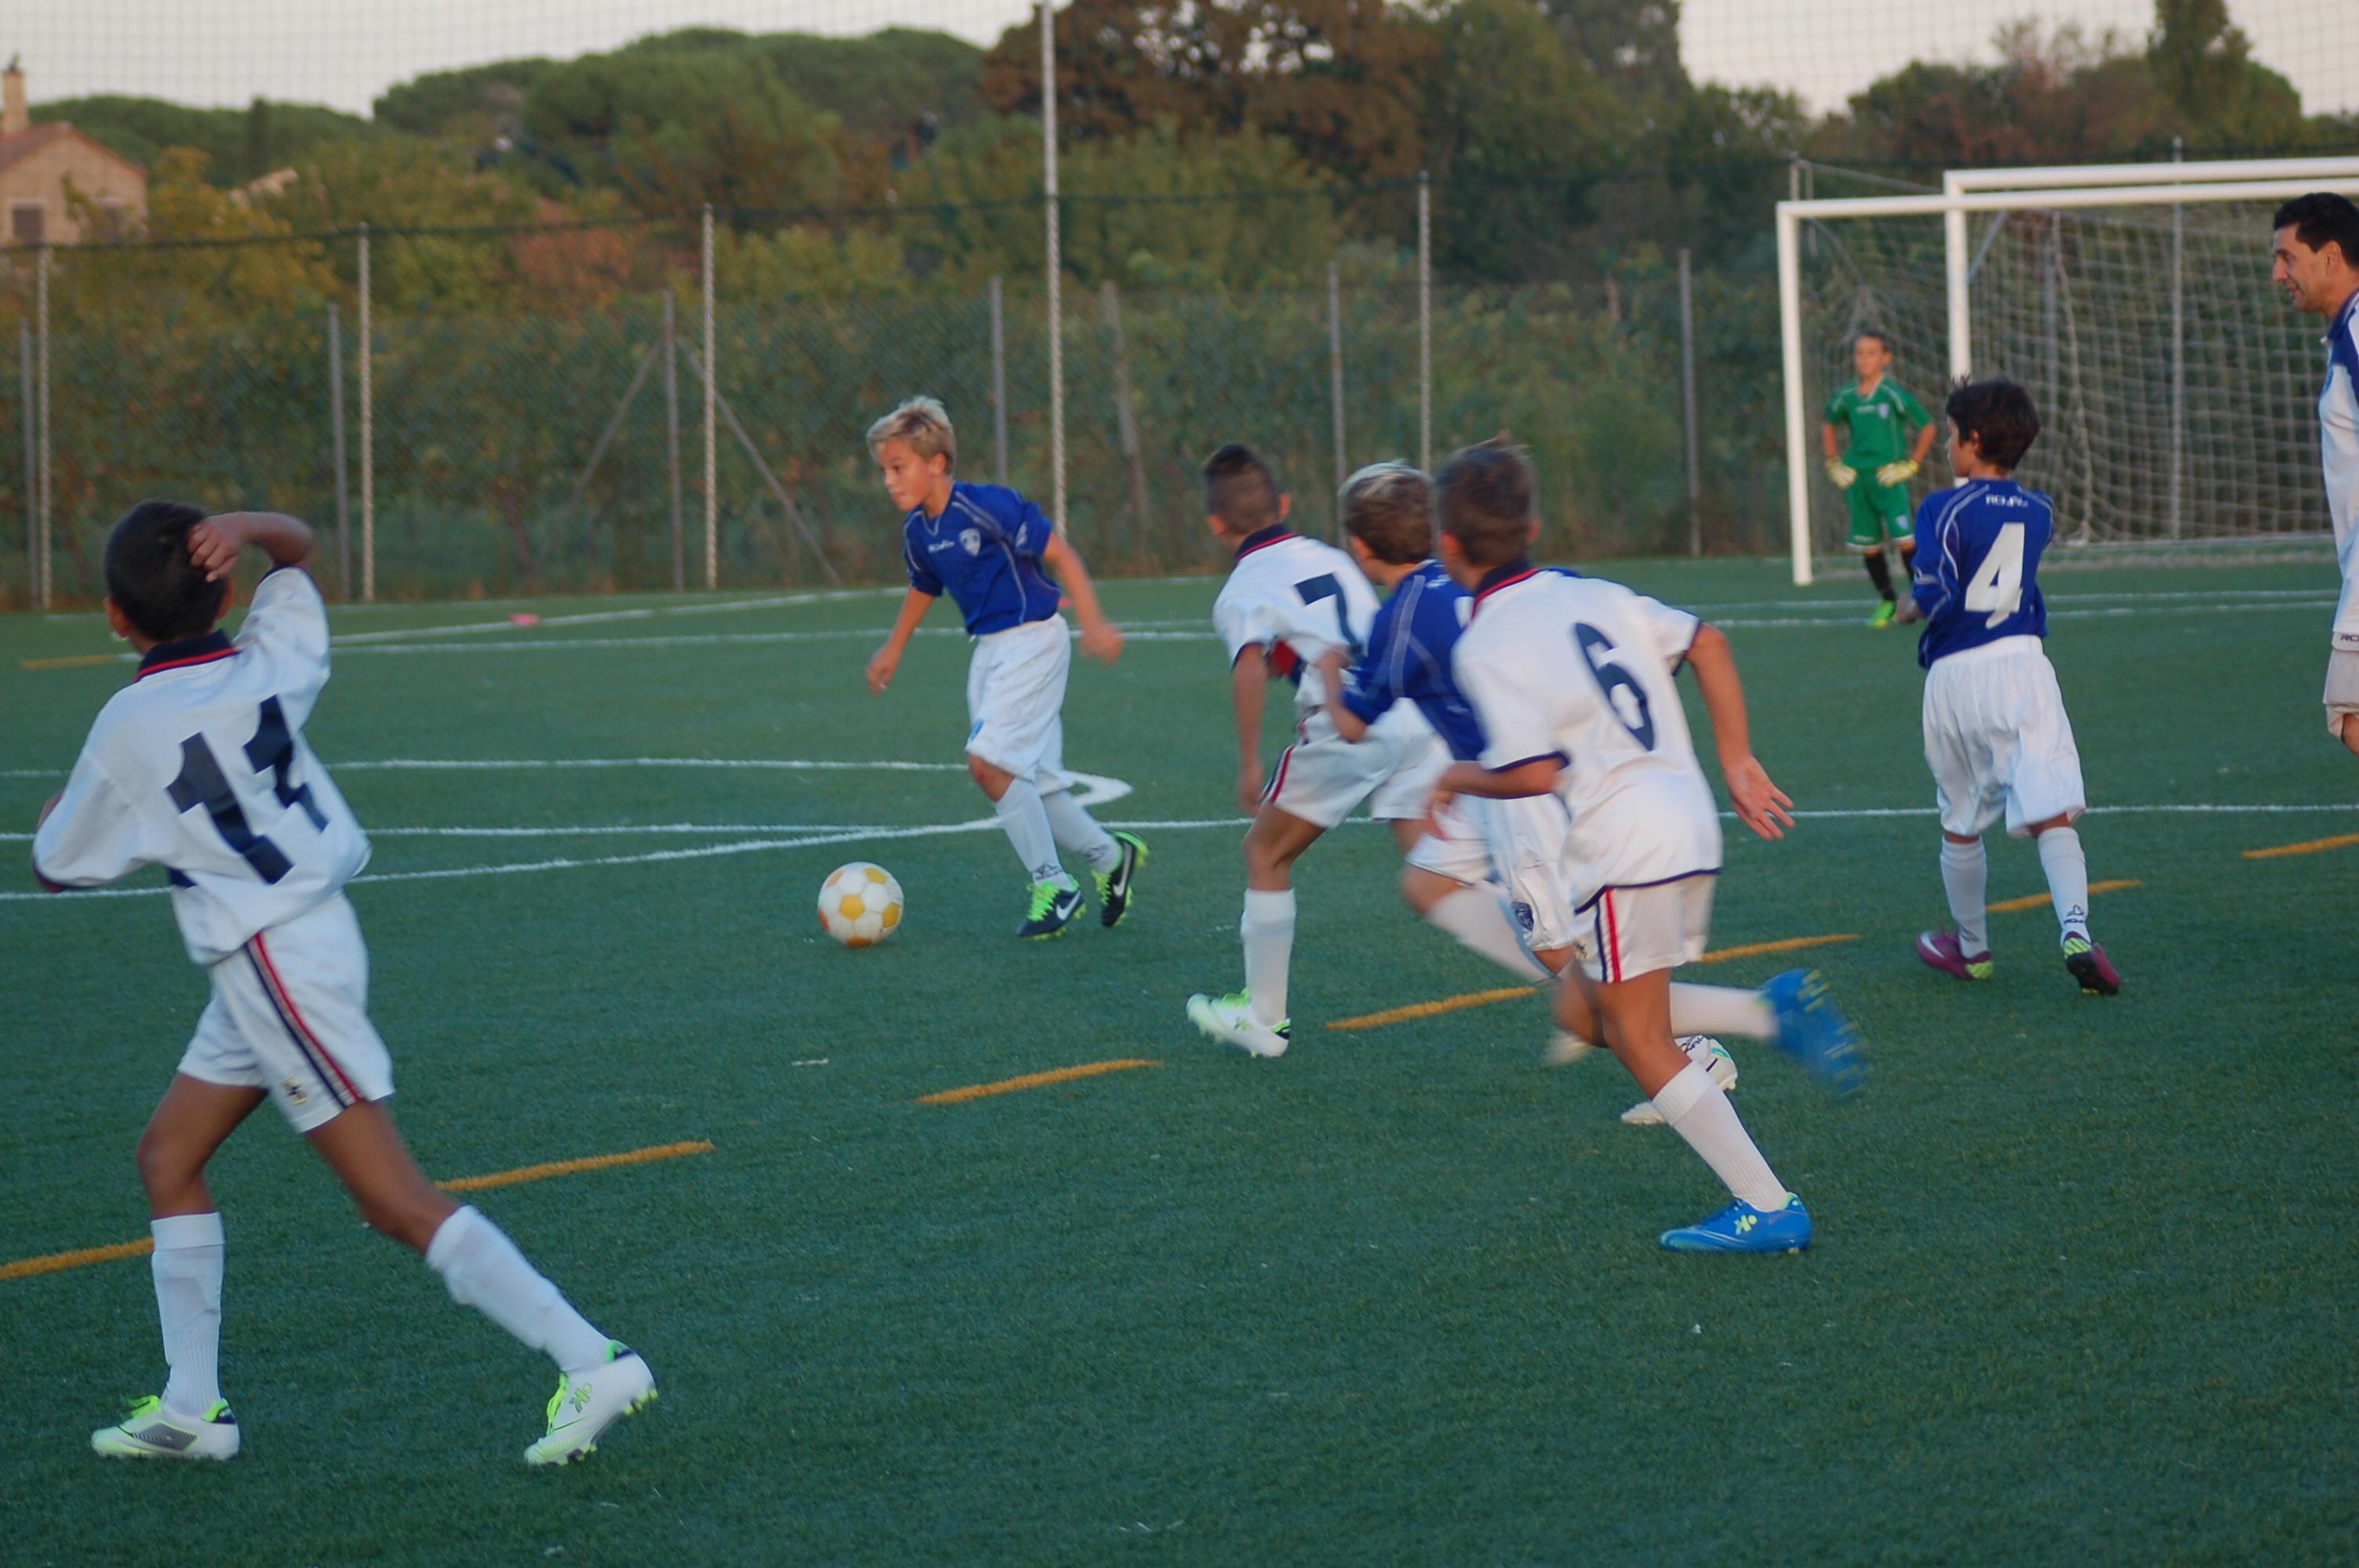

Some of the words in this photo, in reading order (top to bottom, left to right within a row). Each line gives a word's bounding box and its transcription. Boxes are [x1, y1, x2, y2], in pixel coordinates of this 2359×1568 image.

[1295, 573, 1365, 665] 7
[1965, 522, 2024, 629] 4
[1574, 622, 1654, 752] 6
[165, 694, 330, 884] 11
